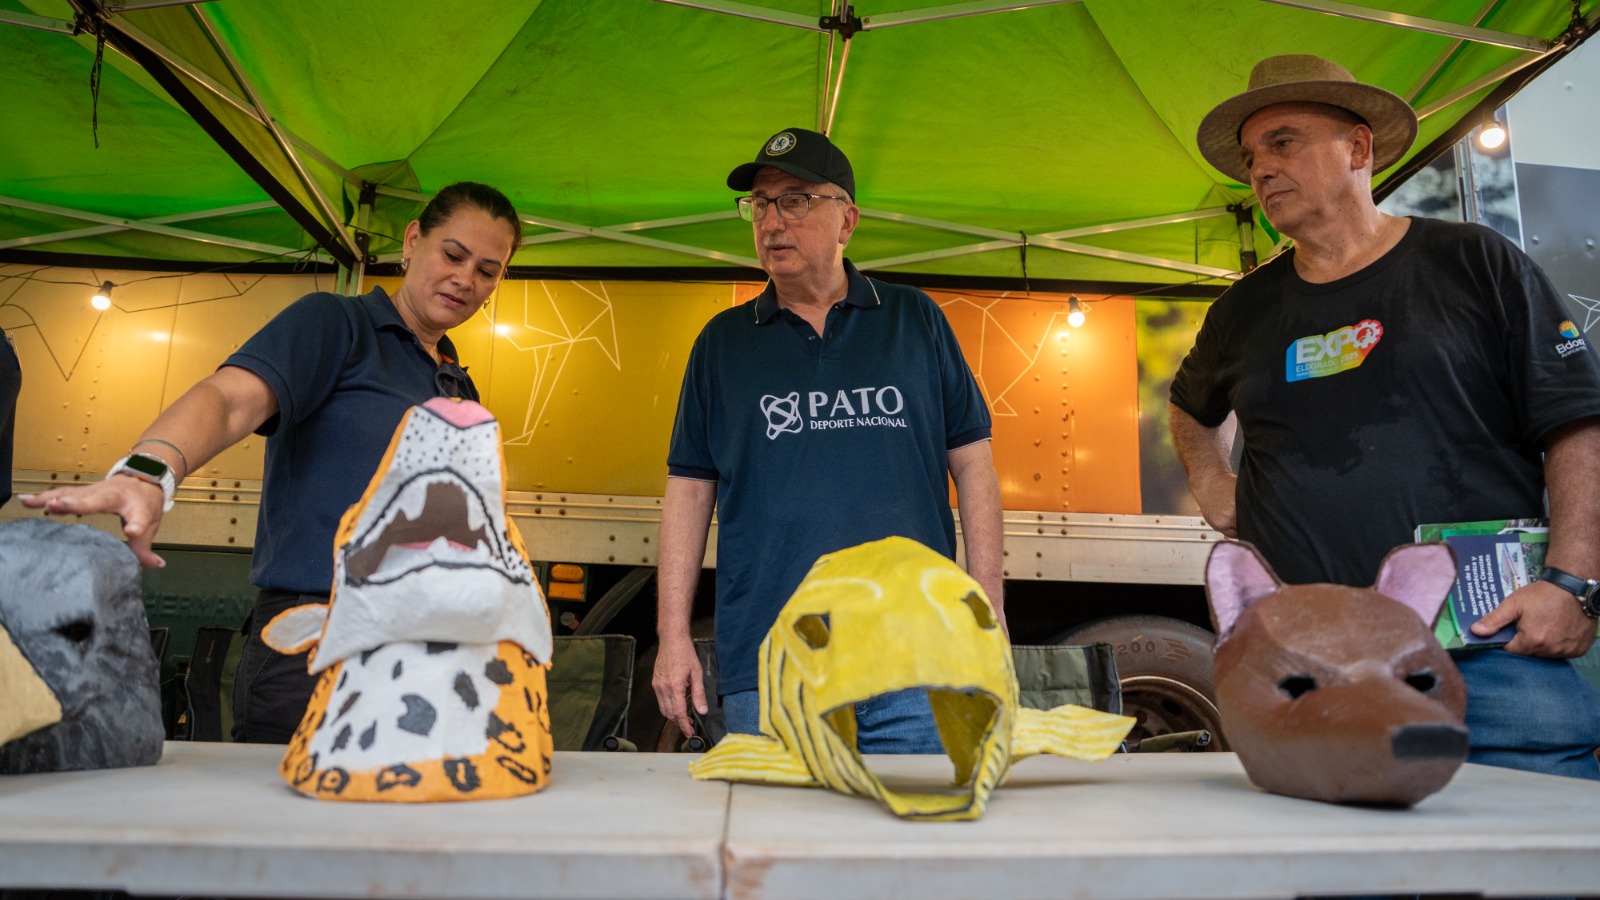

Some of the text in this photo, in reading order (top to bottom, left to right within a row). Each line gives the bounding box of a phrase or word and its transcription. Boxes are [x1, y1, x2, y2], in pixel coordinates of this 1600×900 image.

[1296, 322, 1381, 364] EXPO
[1295, 359, 1338, 372] ELDORADO
[808, 386, 904, 417] PATO
[810, 416, 908, 430] DEPORTE NACIONAL
[1465, 572, 1472, 581] de
[1472, 562, 1483, 599] Agrotécnica
[1478, 554, 1487, 580] Ciencias
[1485, 554, 1494, 582] Eldorado
[1467, 582, 1479, 616] Recuerdos
